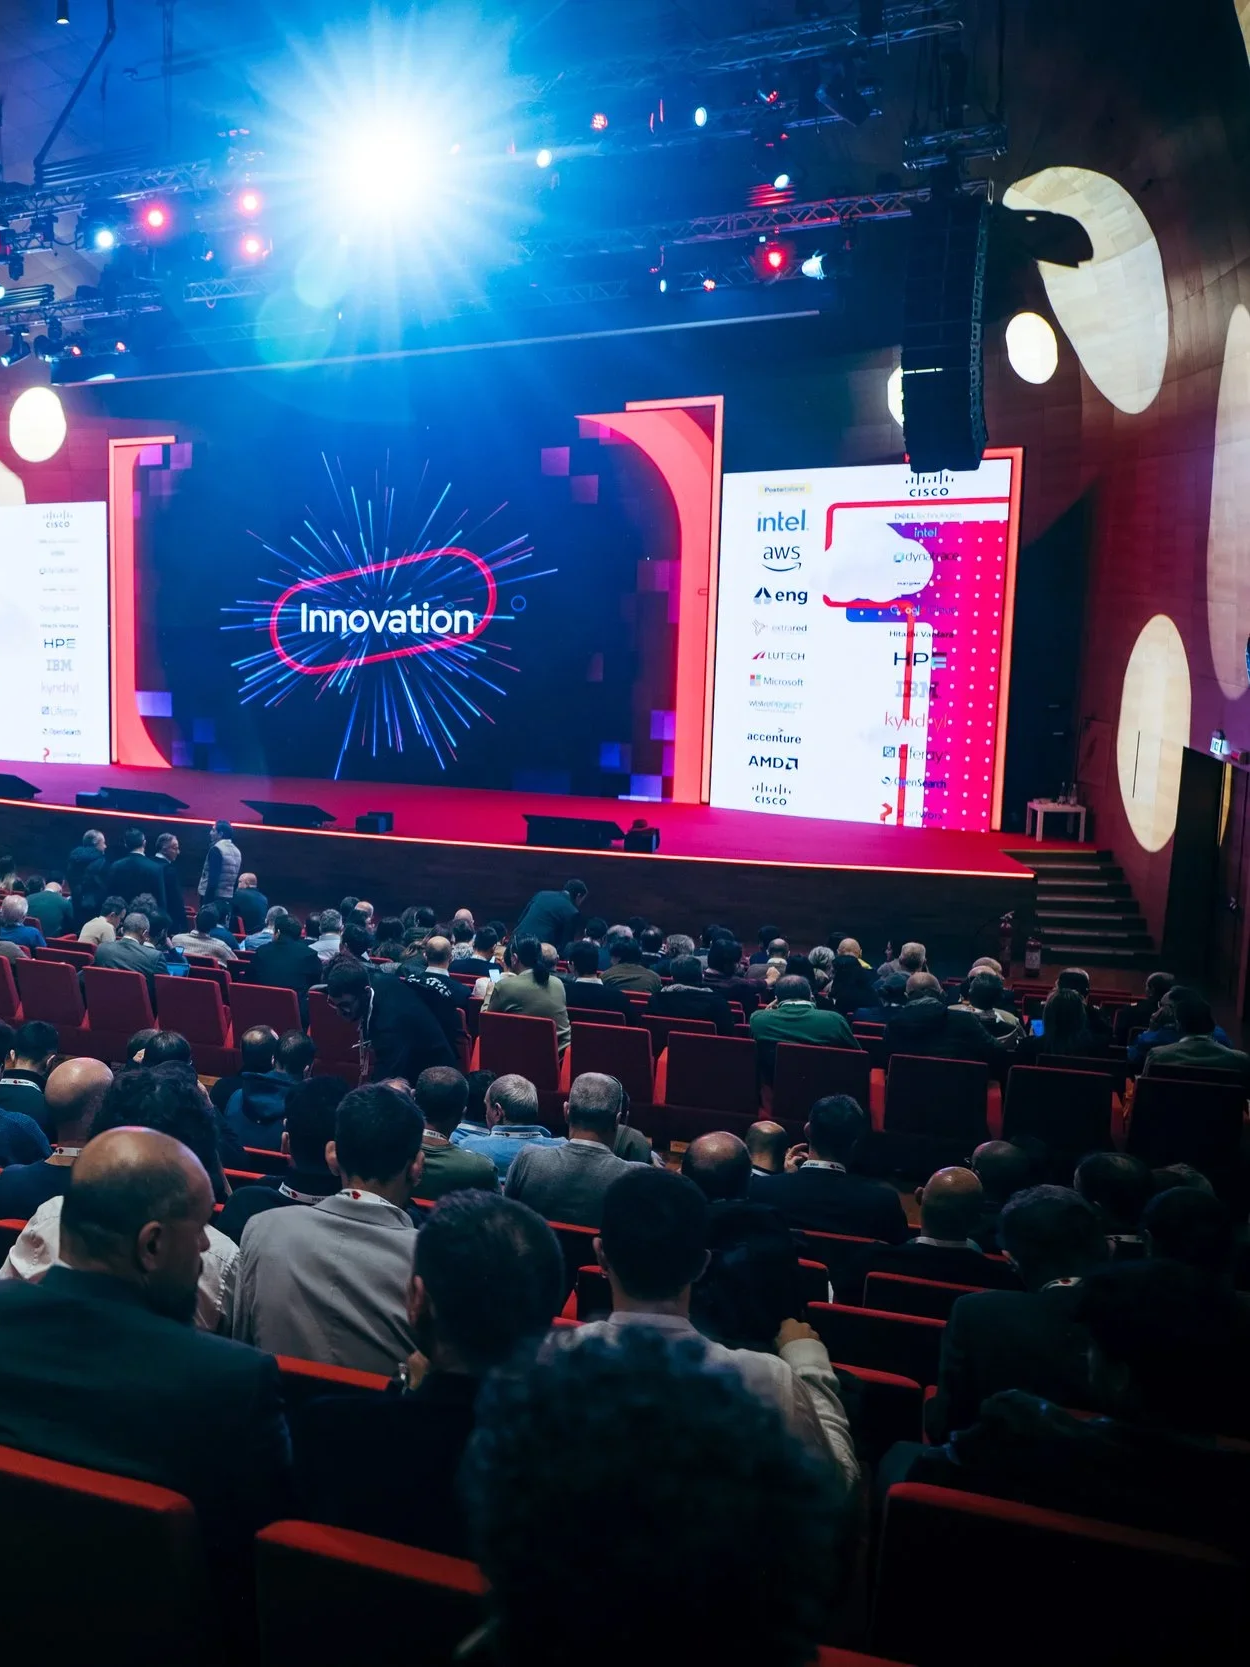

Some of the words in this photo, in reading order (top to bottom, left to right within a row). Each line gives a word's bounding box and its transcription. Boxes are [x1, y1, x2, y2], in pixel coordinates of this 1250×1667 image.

[909, 487, 949, 498] CISCO
[45, 520, 71, 529] CISCO
[756, 508, 806, 533] intel
[914, 526, 938, 538] intel
[762, 545, 801, 561] aws
[775, 590, 808, 606] eng
[300, 601, 475, 635] Innovation
[43, 637, 77, 650] HPE
[767, 651, 805, 661] LUTECH
[893, 651, 948, 670] HPE
[45, 658, 74, 672] IBM
[763, 676, 804, 687] Microsoft
[894, 680, 942, 699] IBM
[884, 711, 948, 733] kyndyl
[747, 731, 802, 745] accenture
[748, 755, 785, 769] AMD
[754, 795, 788, 806] CISCO
